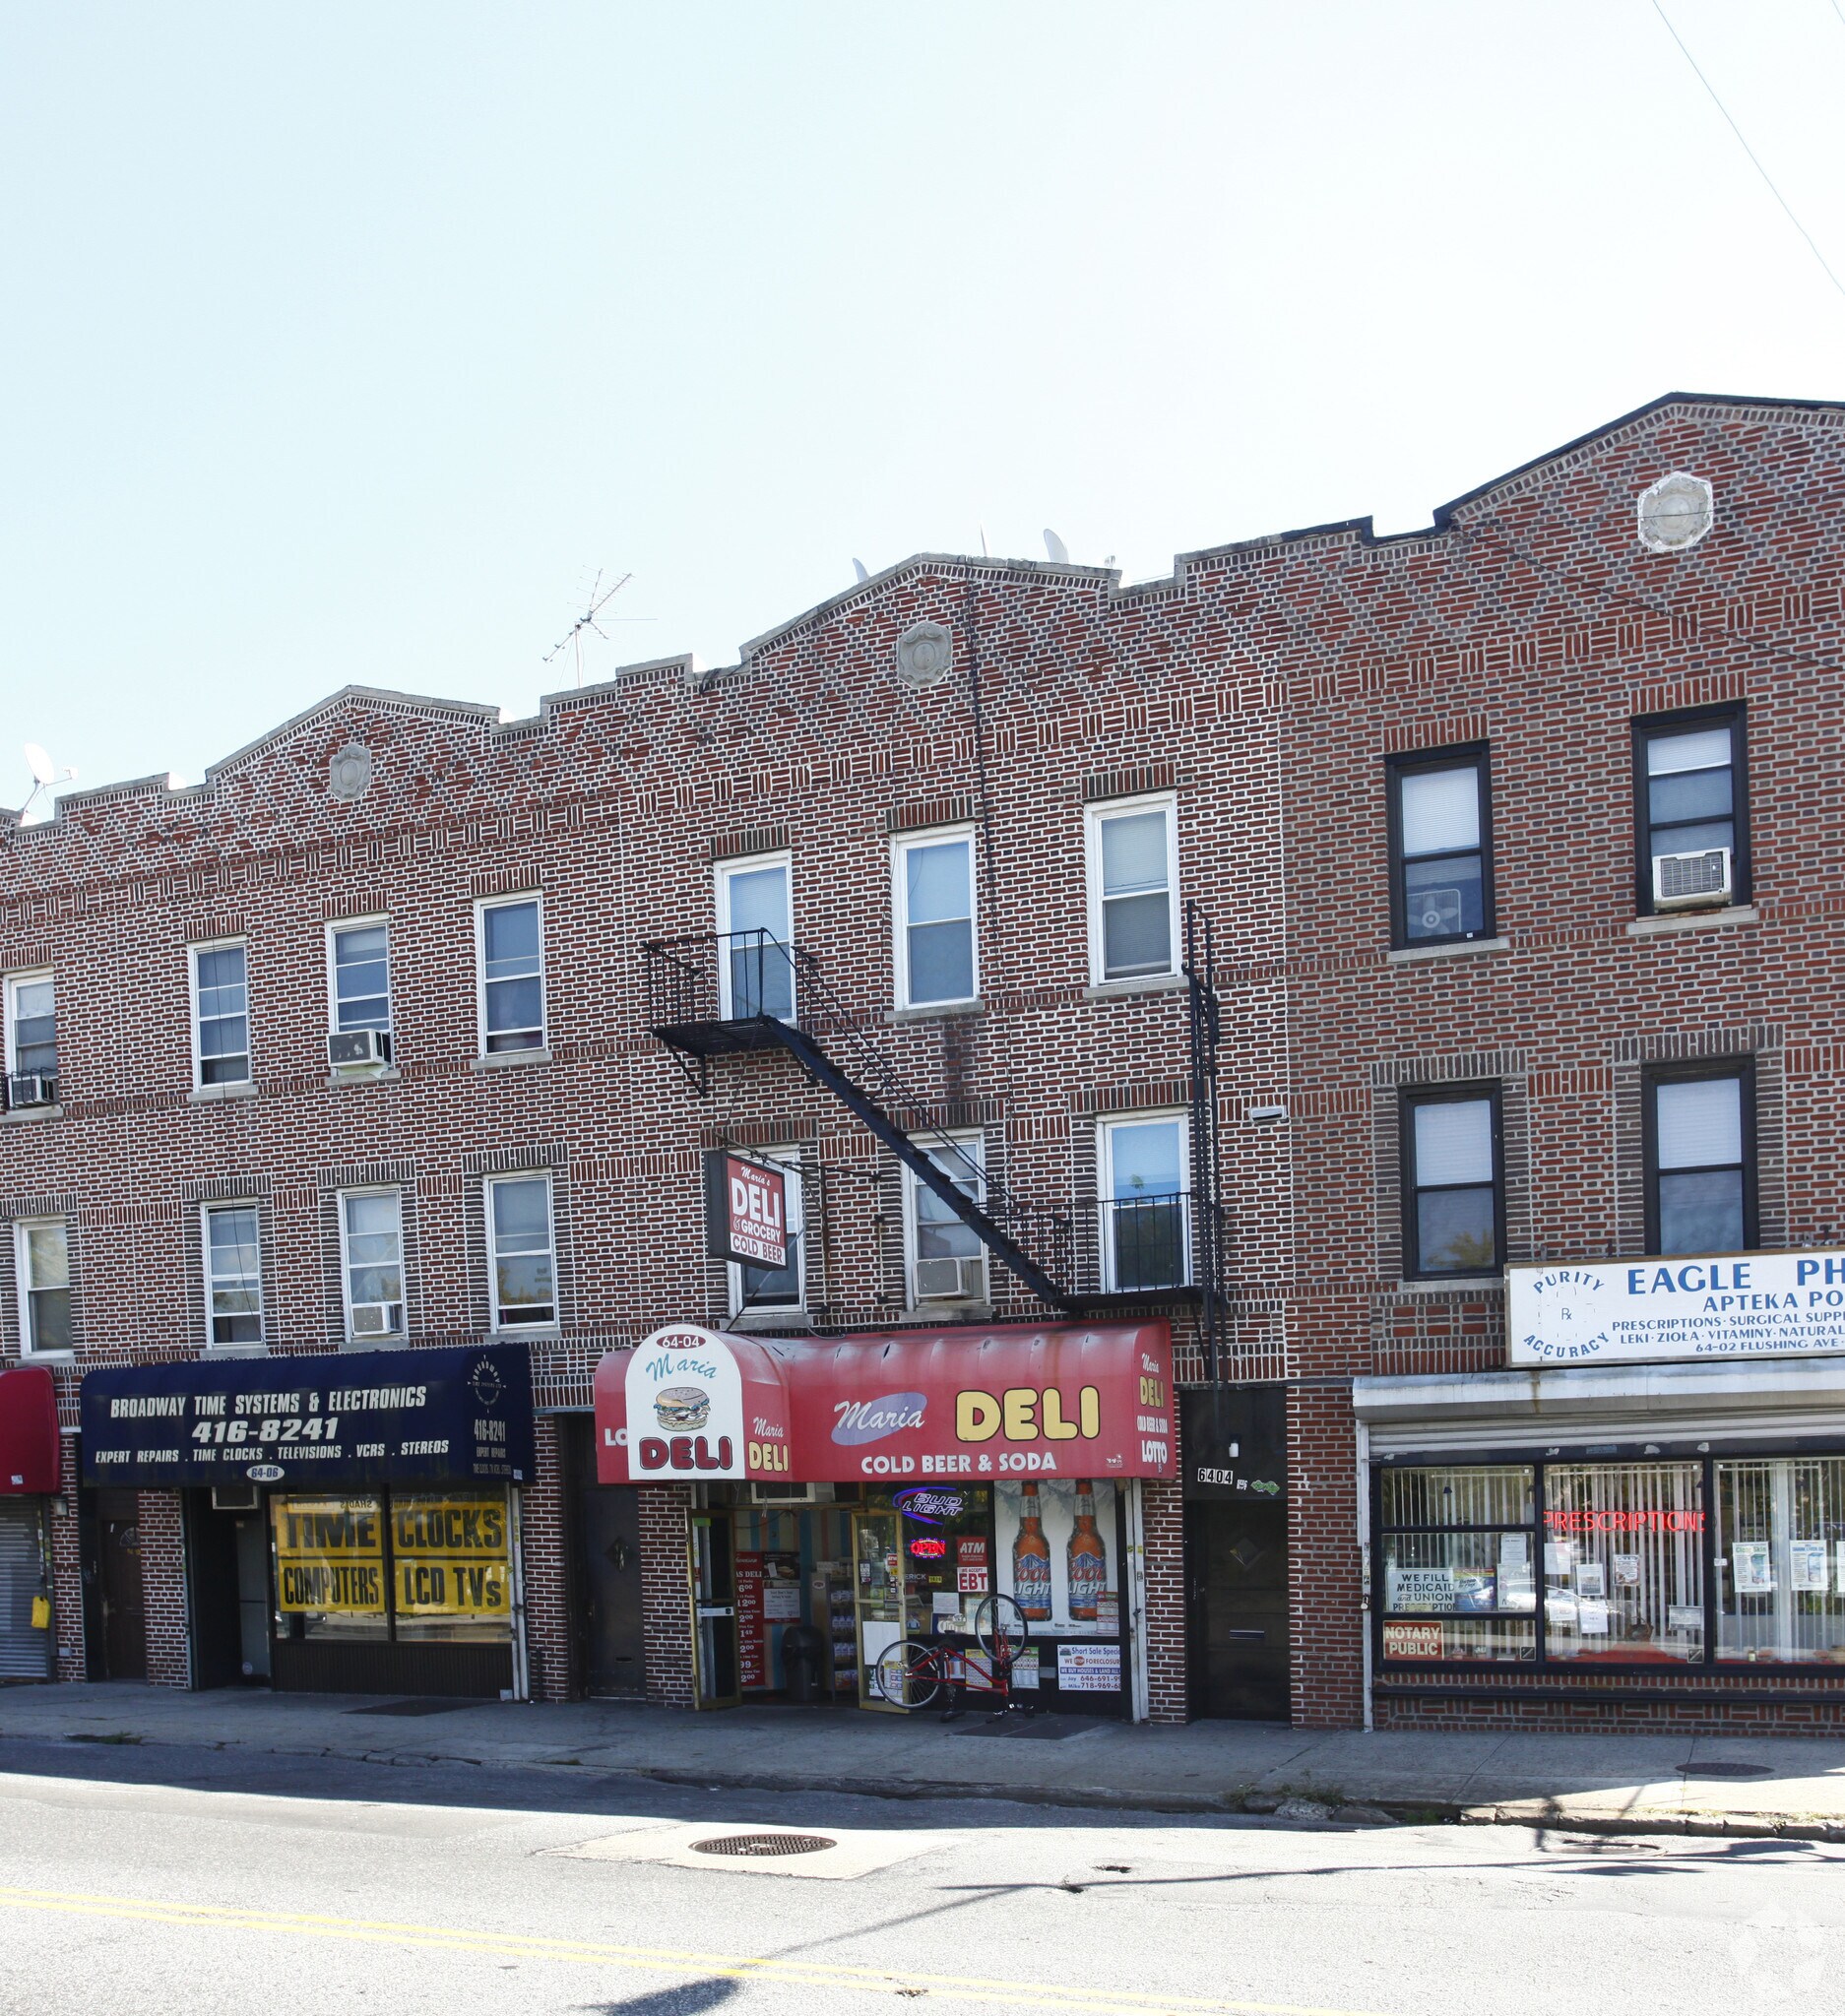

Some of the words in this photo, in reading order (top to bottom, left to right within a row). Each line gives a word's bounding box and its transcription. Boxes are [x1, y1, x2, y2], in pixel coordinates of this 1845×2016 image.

[740, 1166, 770, 1186] Maria's
[732, 1177, 781, 1228] DELI
[740, 1221, 781, 1243] GROCERY
[732, 1234, 758, 1256] COLD
[762, 1242, 783, 1263] BEER
[1533, 1271, 1605, 1294] PURITY
[1627, 1263, 1751, 1294] EAGLE
[1797, 1258, 1845, 1287] PH
[1703, 1292, 1798, 1312] APTEKA
[1809, 1290, 1845, 1307] PO
[1612, 1316, 1721, 1331] PRESCRIPTIONS
[1730, 1313, 1801, 1327] SURGICAL
[662, 1335, 700, 1349] 64-04
[1620, 1333, 1649, 1344] LEKI
[1657, 1331, 1699, 1343] ZIOŁA
[1708, 1328, 1772, 1340] VITAMINY
[1779, 1324, 1845, 1338] NATURAL
[1523, 1332, 1610, 1358] ACCURACY
[1695, 1343, 1736, 1353] 64-02
[1741, 1339, 1809, 1352] FLUSHING
[1813, 1338, 1838, 1349] AVE
[645, 1354, 717, 1381] Maria
[1141, 1353, 1159, 1374] Maria
[110, 1397, 186, 1418] BROADWAY
[194, 1396, 226, 1416] TIME
[234, 1393, 300, 1415] SYSTEMS
[308, 1392, 320, 1413] &
[328, 1386, 427, 1412] ELECTRONICS
[1139, 1374, 1164, 1409] DELI
[834, 1400, 925, 1430] Maria
[955, 1385, 1101, 1443] DELI
[191, 1418, 339, 1443] 416-8241
[474, 1418, 506, 1441] 416-8241
[753, 1417, 785, 1438] Maria
[95, 1451, 130, 1463] EXPERT
[137, 1449, 179, 1463] REPAIRS
[193, 1449, 217, 1462] TIME
[223, 1447, 263, 1461] CLOCKS
[278, 1445, 342, 1460] TELEVISIONS
[356, 1443, 385, 1457] VCRS
[401, 1439, 449, 1455] STEREOS
[639, 1436, 733, 1471] DELI
[748, 1440, 789, 1472] DELI
[1141, 1439, 1168, 1464] LOTTO
[250, 1467, 279, 1478] 64-06
[860, 1456, 915, 1474] COLD
[922, 1454, 972, 1473] BEER
[978, 1454, 992, 1472] &
[998, 1452, 1057, 1471] SODA
[1198, 1468, 1233, 1484] 6404
[902, 1500, 964, 1516] LIGHT
[914, 1492, 963, 1507] BUD
[286, 1510, 376, 1548] TIME
[398, 1509, 502, 1548] CLOCKS
[910, 1541, 946, 1555] OPEN
[959, 1542, 986, 1553] ATM
[285, 1567, 379, 1605] COMPUTERS
[404, 1566, 446, 1605] LCD
[958, 1573, 988, 1591] EBT
[1396, 1583, 1454, 1592] MEDICAID
[1424, 1573, 1449, 1582] FILL
[1014, 1582, 1051, 1597] LIGHT
[1068, 1581, 1107, 1596] LIGHT
[1414, 1593, 1453, 1602] UNION
[1385, 1626, 1440, 1640] NOTARY
[1389, 1642, 1438, 1655] PUBLIC
